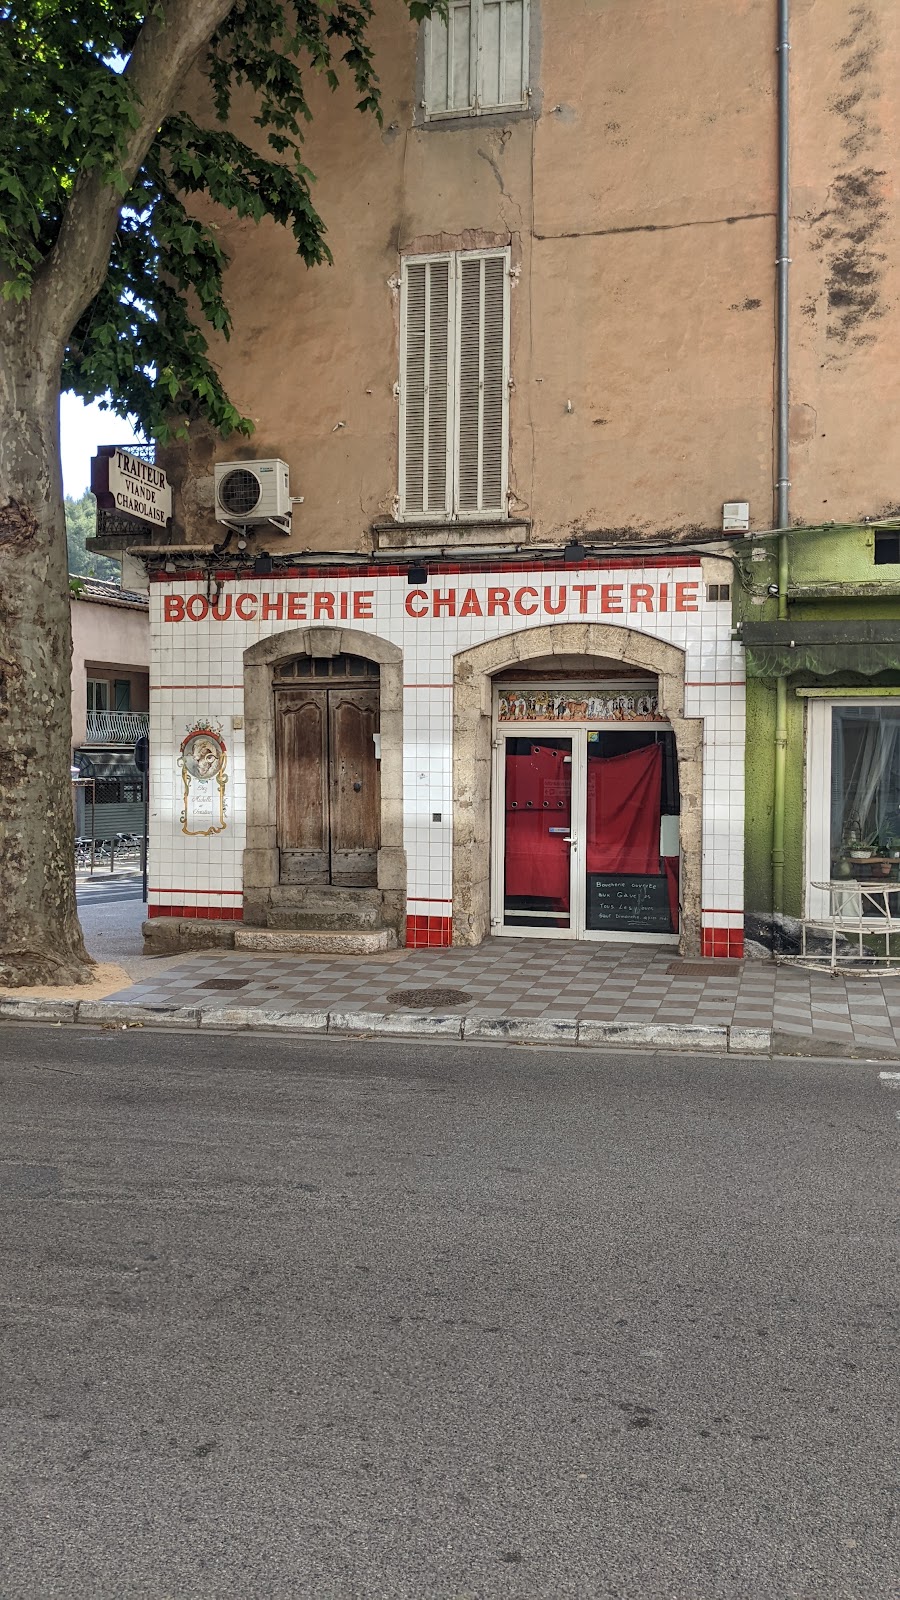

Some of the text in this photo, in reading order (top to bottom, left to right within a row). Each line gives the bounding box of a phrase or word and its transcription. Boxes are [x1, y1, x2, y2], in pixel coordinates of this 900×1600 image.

[116, 450, 166, 490] TRAITEUR
[116, 492, 165, 523] CHAROLAISE
[125, 479, 156, 504] VIANDE
[164, 582, 699, 622] BOUCHERIE CHARCUTERIE
